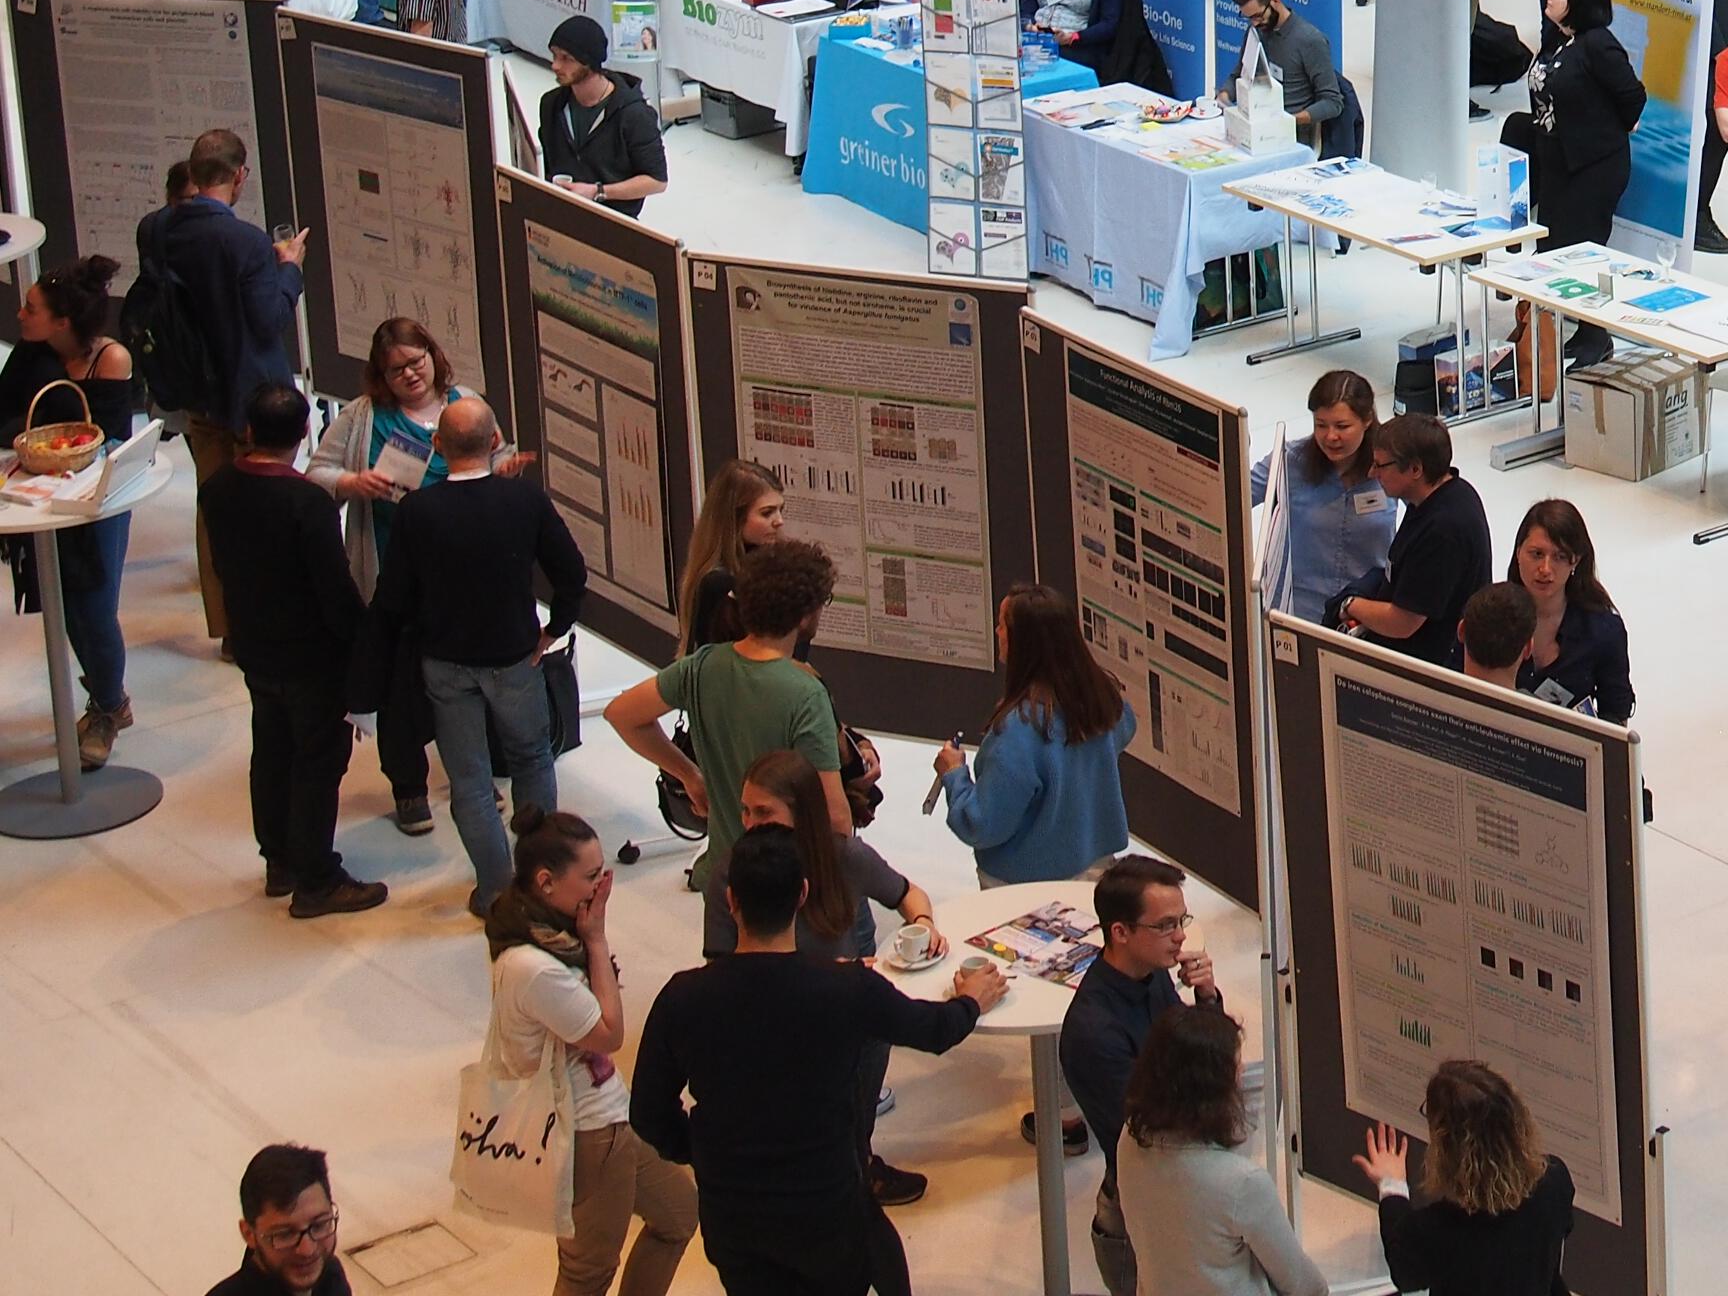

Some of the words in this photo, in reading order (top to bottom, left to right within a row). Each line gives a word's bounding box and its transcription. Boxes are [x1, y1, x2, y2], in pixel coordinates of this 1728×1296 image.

[840, 136, 897, 178] greiner
[704, 272, 713, 281] 04
[766, 279, 812, 292] Biosynthesis
[821, 286, 855, 297] histidine,
[856, 290, 887, 301] arginine,
[889, 294, 922, 304] riboflavin
[773, 290, 816, 303] pantothenic
[817, 295, 832, 305] acid,
[907, 306, 932, 315] crucial
[788, 301, 799, 309] for
[800, 303, 832, 314] virulence
[833, 306, 841, 314] of
[842, 308, 883, 320] Aspergillus
[884, 312, 920, 323] fumigatus
[1100, 368, 1129, 388] Functional
[1130, 381, 1156, 400] Analysis
[1156, 394, 1162, 403] of
[1276, 640, 1282, 649] P
[1284, 642, 1293, 652] 01
[1348, 681, 1361, 693] iron
[1395, 700, 1429, 717] complexes
[1430, 709, 1447, 721] exert
[1448, 716, 1463, 729] their
[1465, 722, 1509, 743] anti-leukemic
[1510, 735, 1530, 750] effect
[1531, 743, 1541, 754] via
[1543, 746, 1584, 769] ferroptosis?
